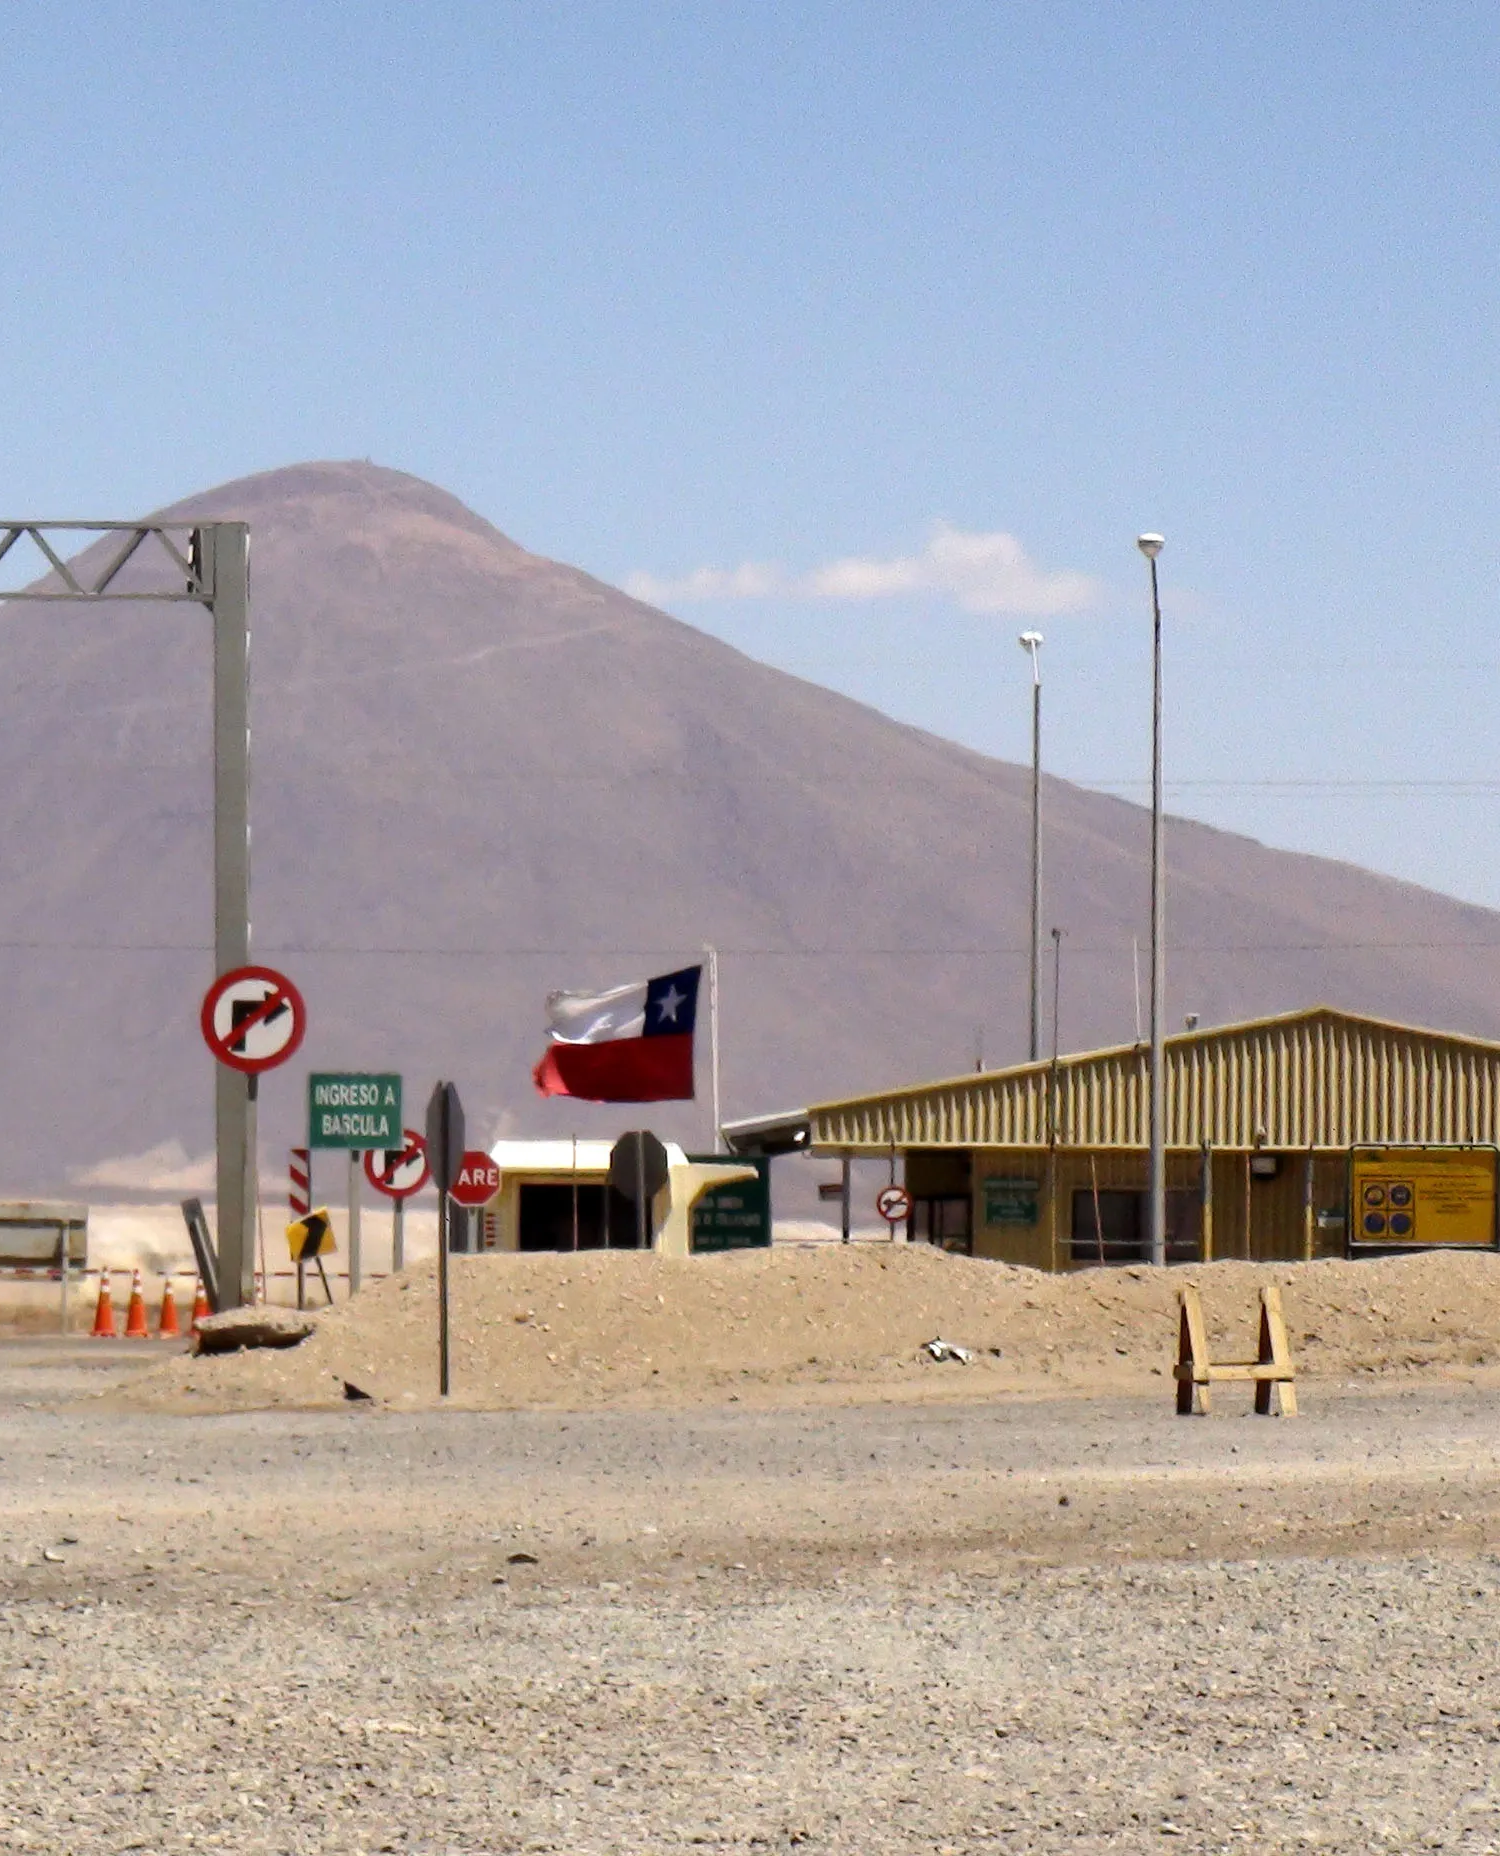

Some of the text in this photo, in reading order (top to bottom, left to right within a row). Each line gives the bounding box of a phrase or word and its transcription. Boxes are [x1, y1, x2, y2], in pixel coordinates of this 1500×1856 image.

[314, 1083, 396, 1107] INGRESO A
[322, 1114, 390, 1137] BASCULA
[458, 1168, 499, 1187] ARE
